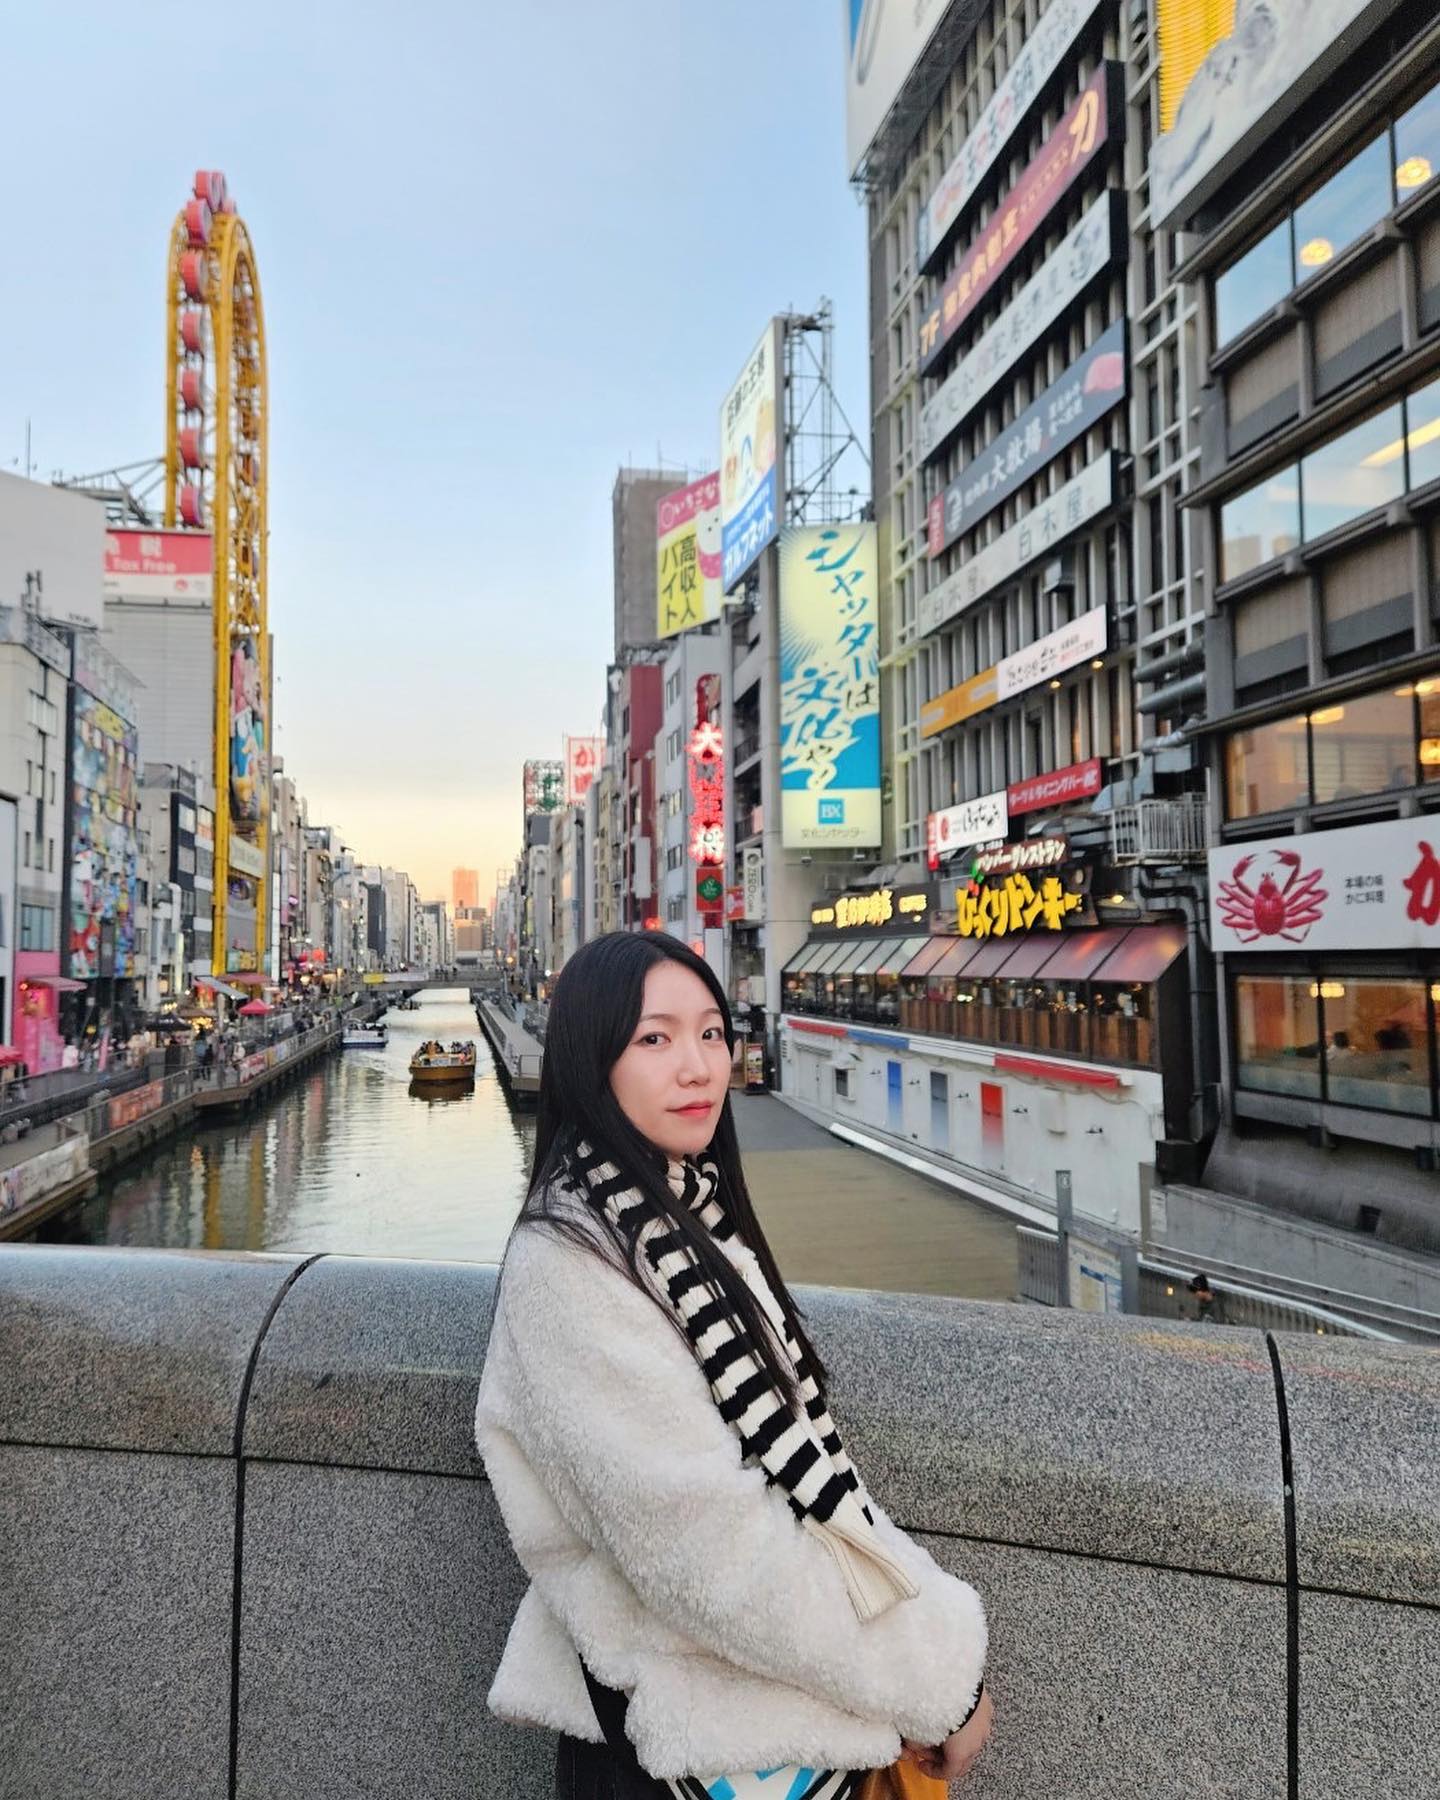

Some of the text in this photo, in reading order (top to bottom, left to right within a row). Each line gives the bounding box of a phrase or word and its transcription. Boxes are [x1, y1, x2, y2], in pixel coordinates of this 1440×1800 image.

[679, 531, 697, 622] 高収入
[821, 802, 842, 818] BX
[956, 873, 1083, 940] びっくりドンキー
[1345, 890, 1385, 905] かに料理
